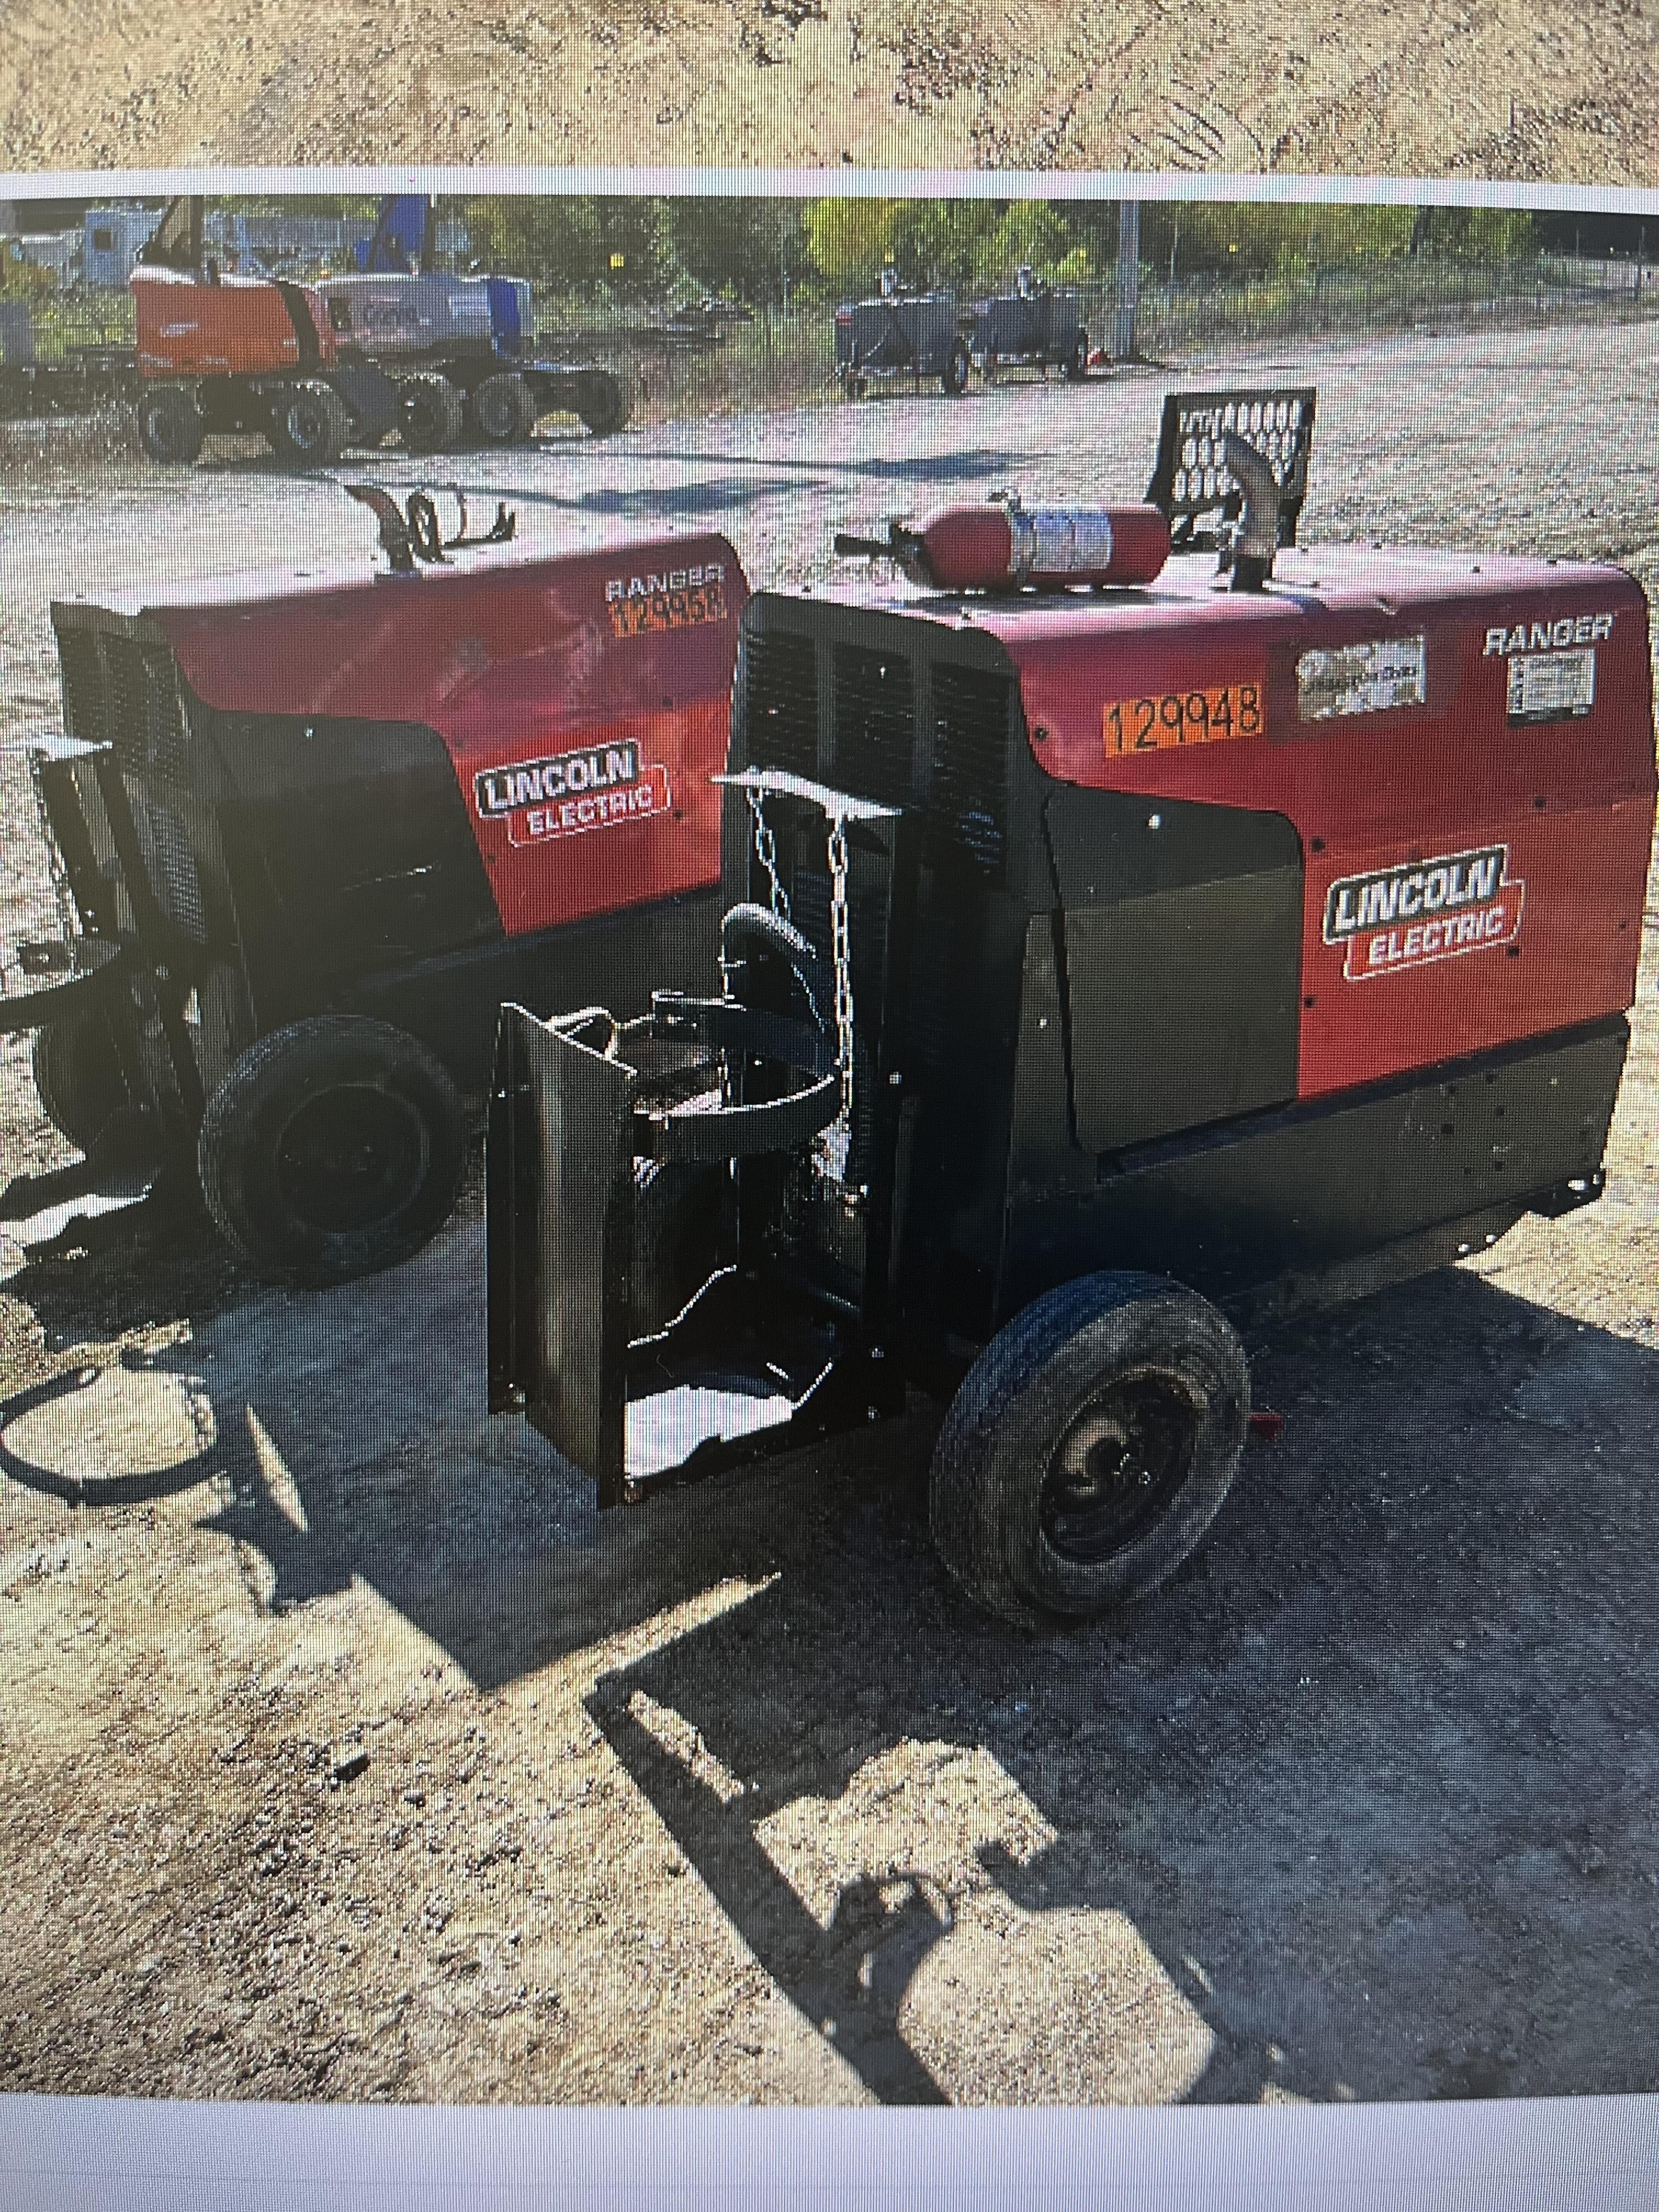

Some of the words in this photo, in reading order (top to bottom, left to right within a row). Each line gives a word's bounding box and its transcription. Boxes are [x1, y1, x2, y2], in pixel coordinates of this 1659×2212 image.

[605, 563, 725, 602] RANGER
[1482, 612, 1615, 657] RANGER
[1108, 685, 1258, 751] 129948
[484, 748, 633, 810] LINCOLN
[527, 785, 653, 835] ELECTRIC
[1335, 855, 1501, 932] LINCOLN
[1368, 905, 1505, 964] ELECTRIC
